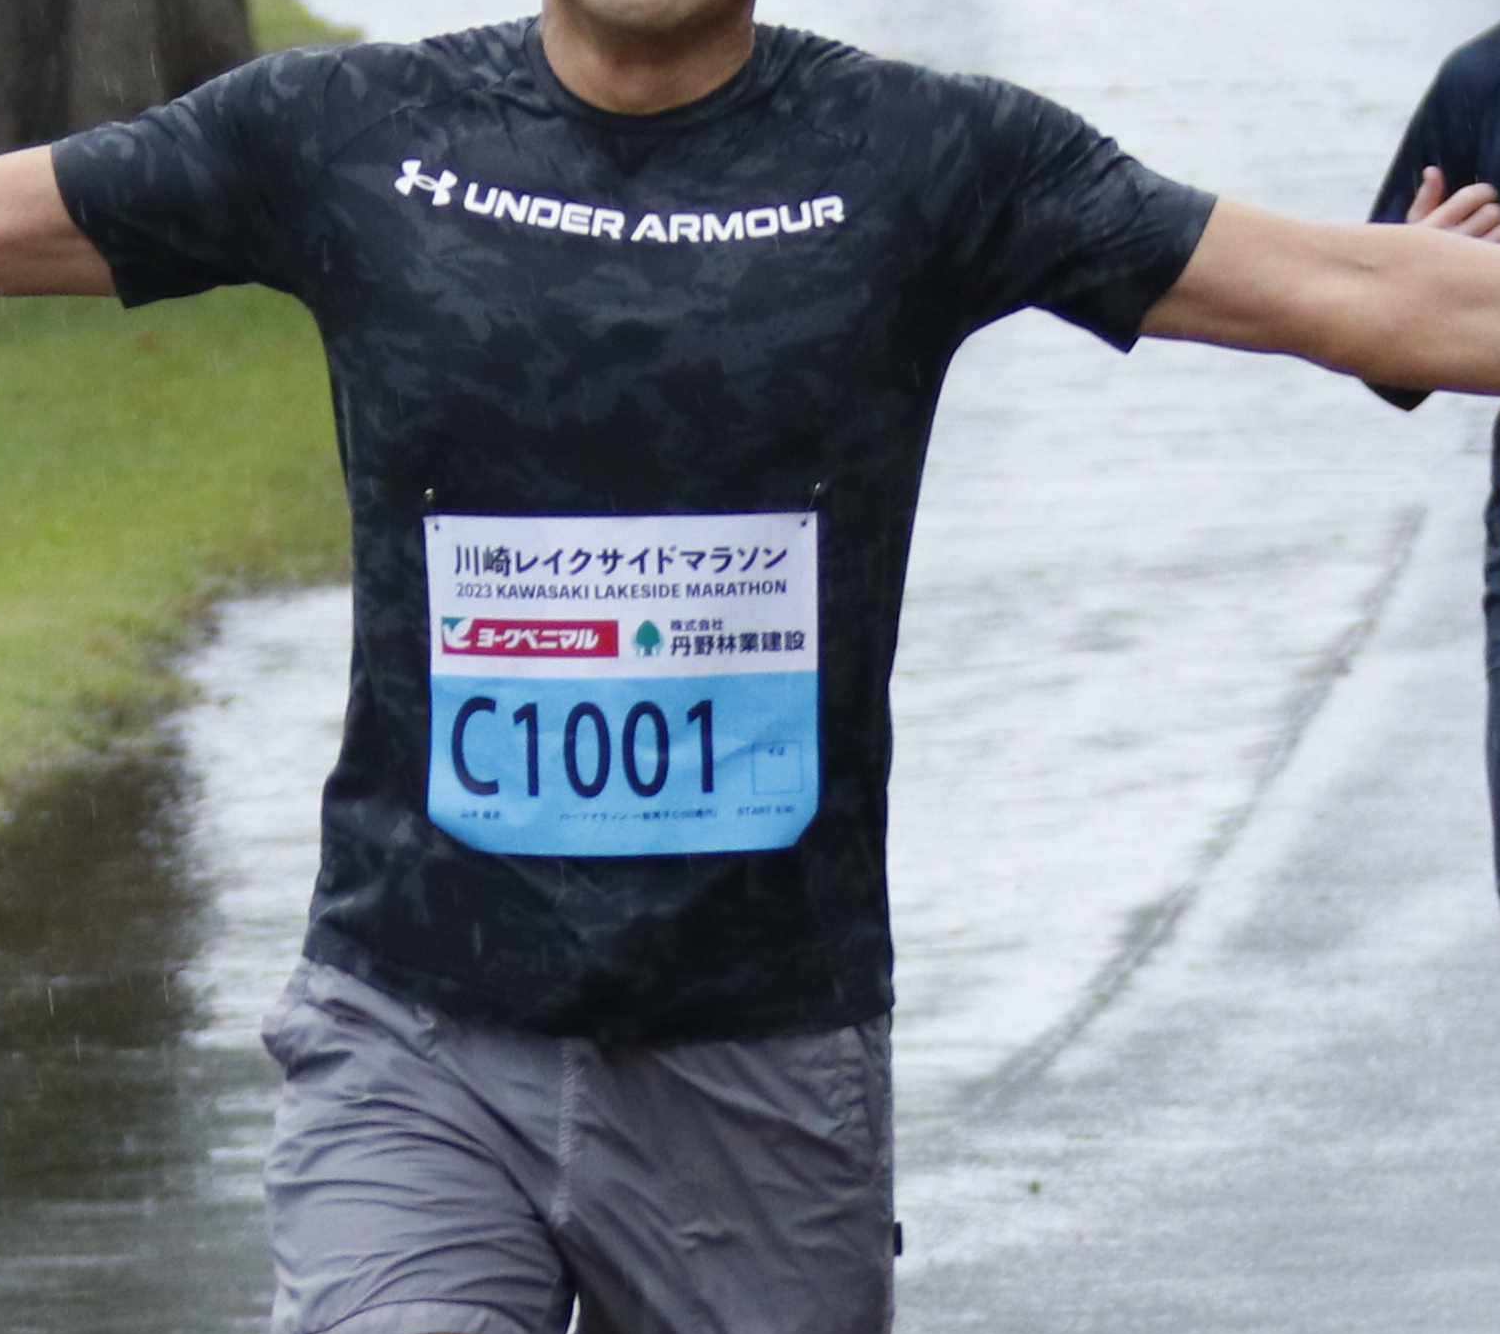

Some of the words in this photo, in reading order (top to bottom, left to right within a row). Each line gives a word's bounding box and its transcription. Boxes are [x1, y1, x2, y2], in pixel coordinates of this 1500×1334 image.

[463, 182, 626, 240] UNDER
[630, 195, 846, 244] ARMOUR
[454, 545, 788, 578] 川崎レイクサイドマラソン
[455, 582, 493, 600] 2023
[496, 582, 589, 600] KAWASAKI
[595, 582, 681, 600] LAKESIDE
[685, 579, 787, 598] MARATHON
[670, 619, 724, 631] 株式会社
[476, 627, 600, 651] ヨークベニマル
[670, 630, 806, 657] 丹野林業建設
[451, 696, 714, 798] C1001
